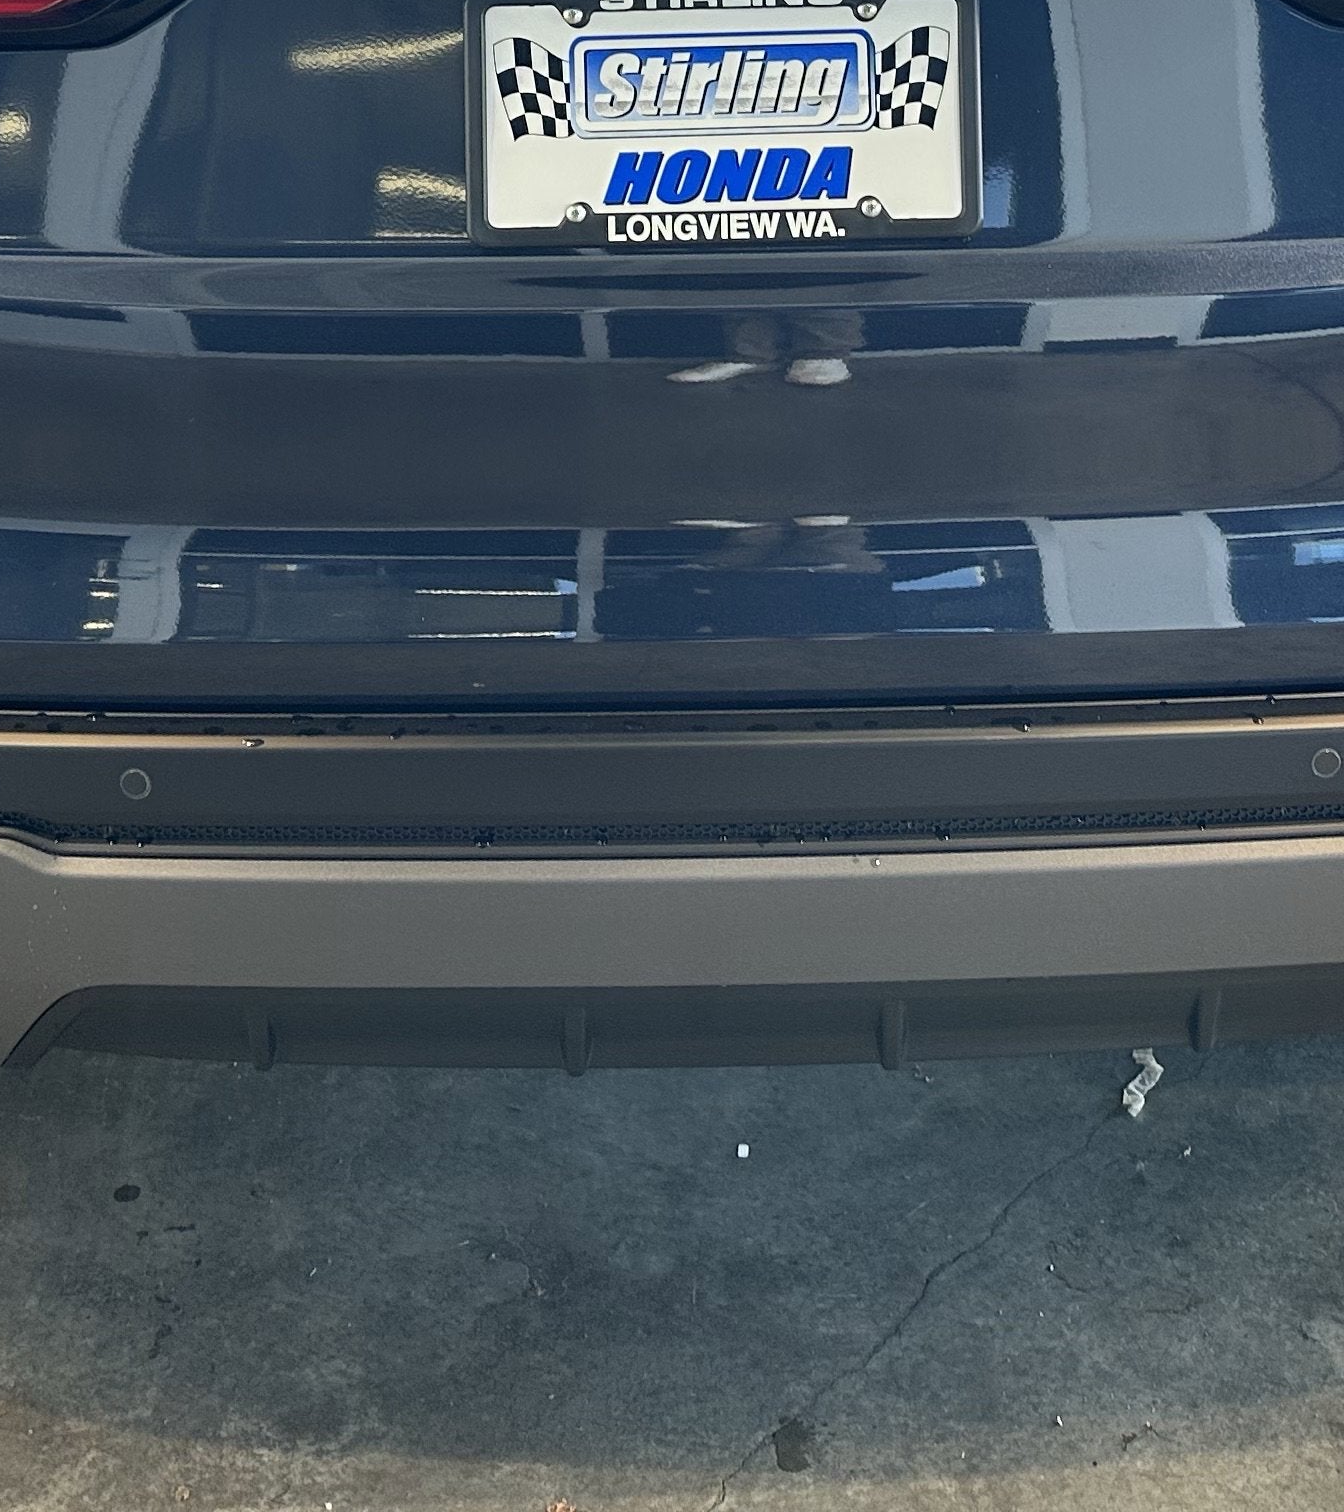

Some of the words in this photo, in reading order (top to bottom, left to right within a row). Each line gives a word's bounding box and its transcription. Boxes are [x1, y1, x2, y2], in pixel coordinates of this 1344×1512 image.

[594, 49, 850, 127] Stirling
[603, 146, 853, 207] HONDA
[606, 213, 783, 242] LONGVIEW
[786, 211, 846, 238] WA.
